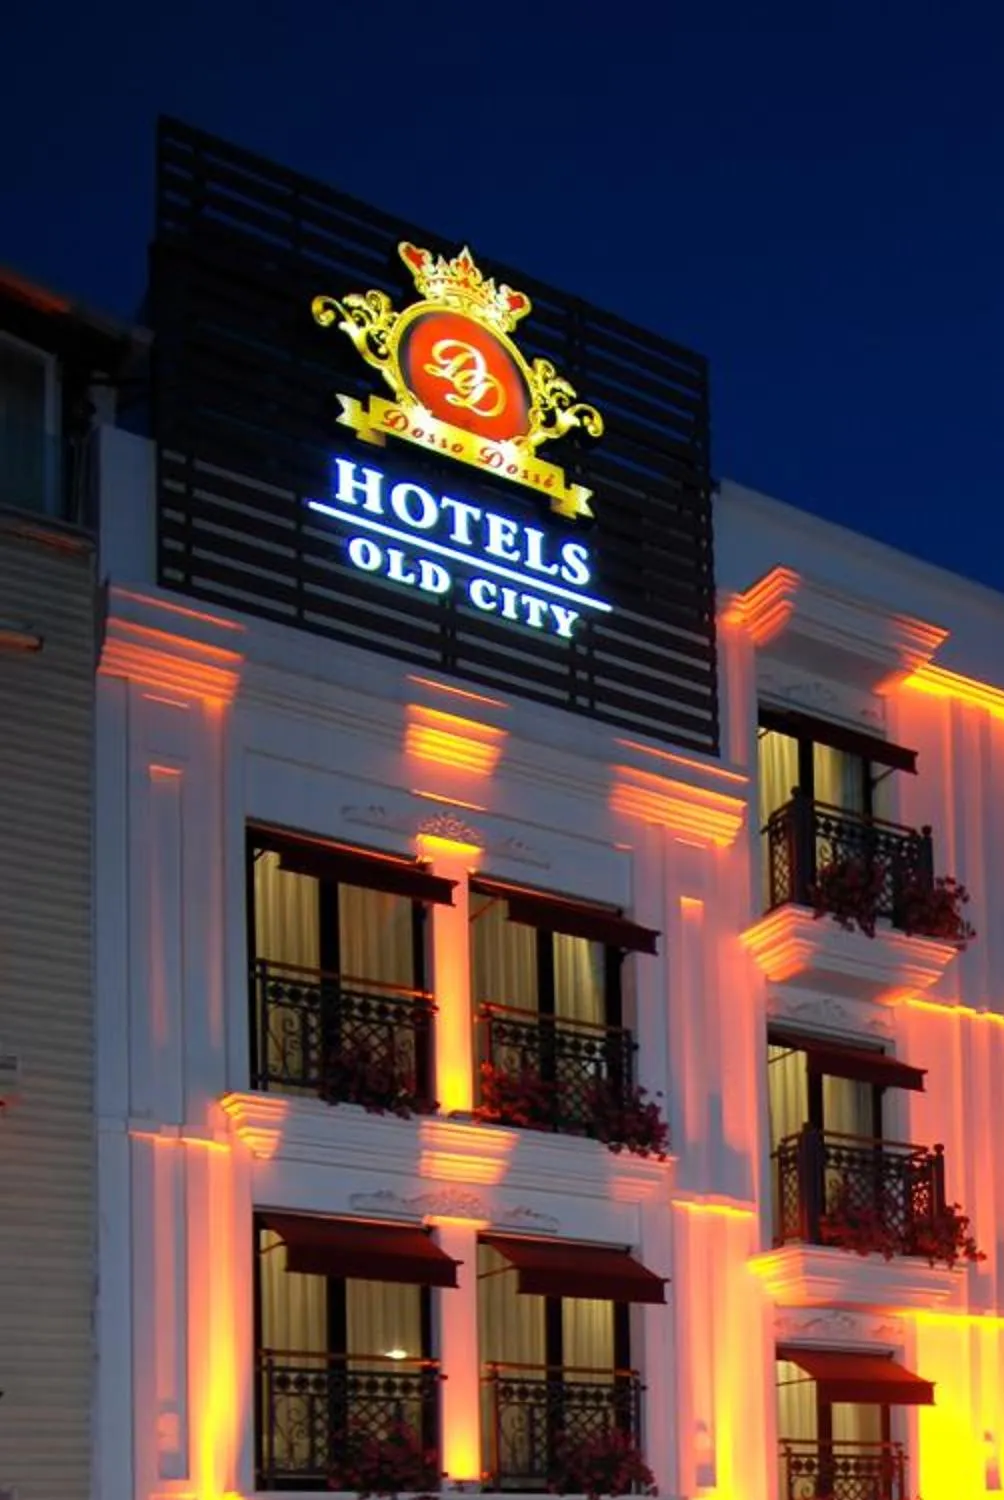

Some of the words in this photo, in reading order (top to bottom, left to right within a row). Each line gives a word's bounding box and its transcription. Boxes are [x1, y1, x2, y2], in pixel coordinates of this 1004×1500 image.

[382, 408, 464, 453] Dosso
[335, 457, 591, 586] HOTELS
[348, 537, 451, 595] OLD
[469, 578, 579, 638] CITY
